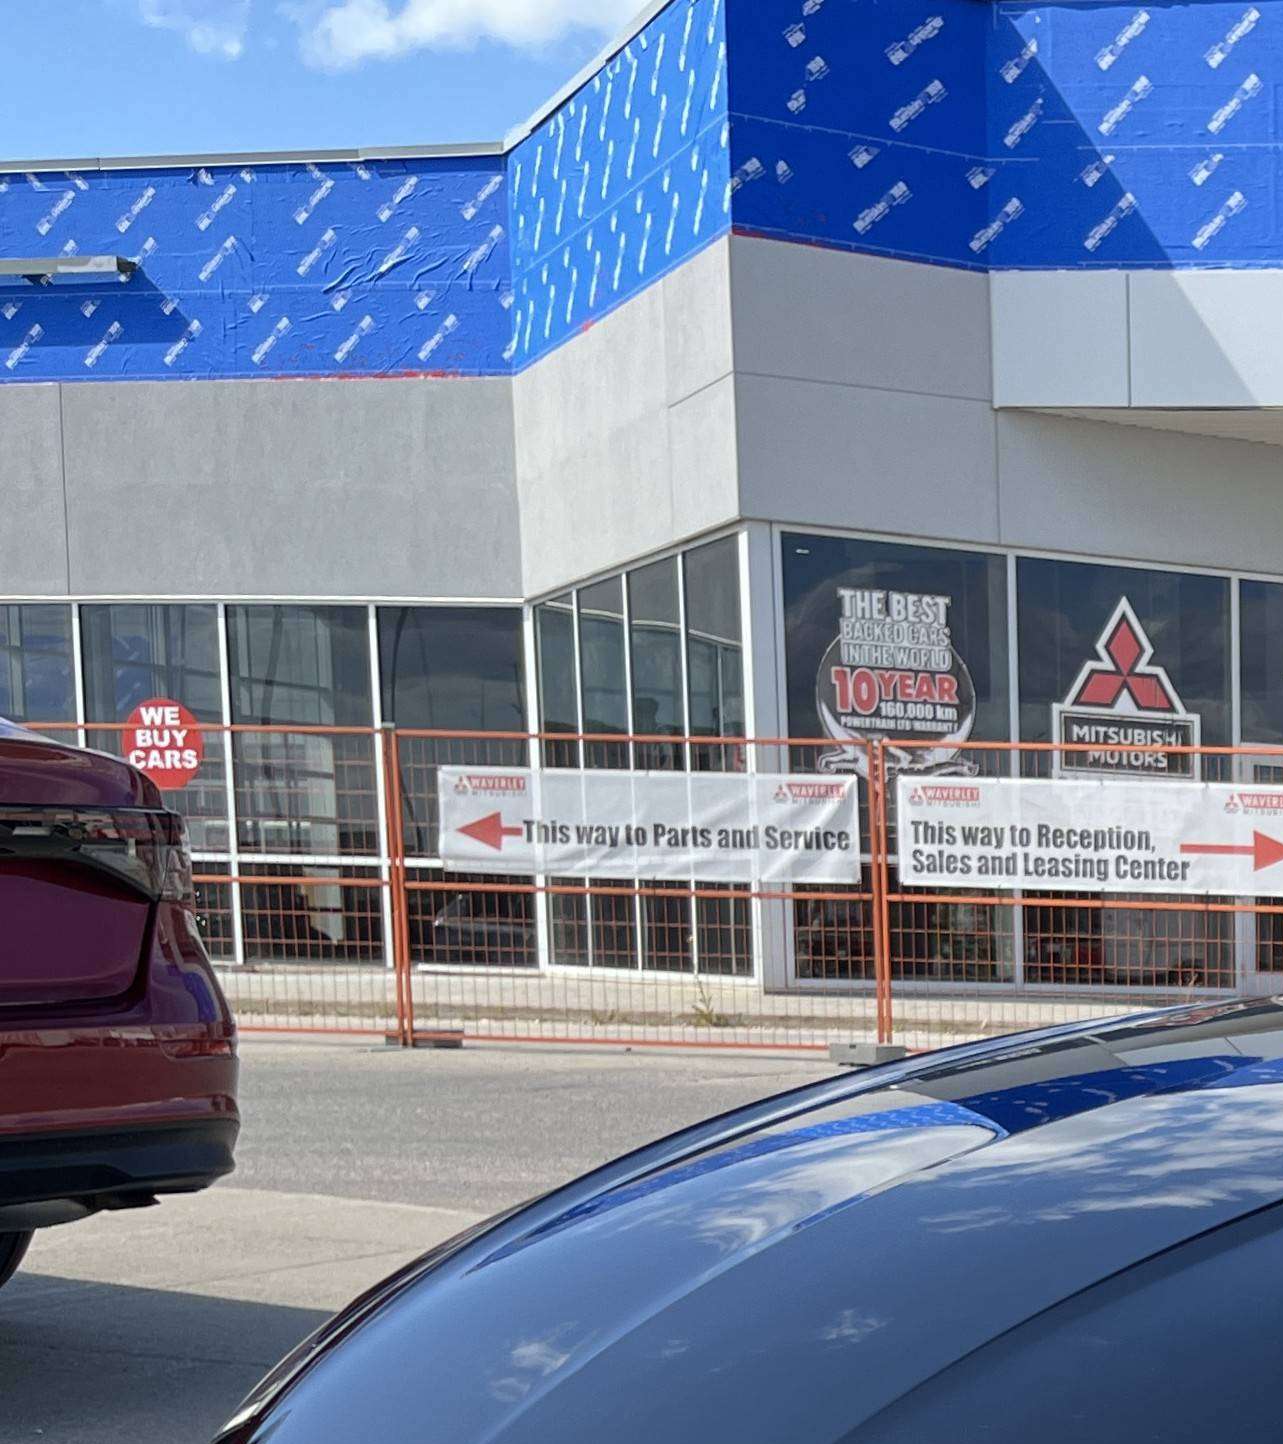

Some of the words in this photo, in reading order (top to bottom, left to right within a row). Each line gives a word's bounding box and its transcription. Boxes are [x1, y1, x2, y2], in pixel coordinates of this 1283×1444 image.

[838, 587, 886, 620] THE
[889, 592, 951, 626] BEST
[841, 620, 903, 644] BACKED
[908, 625, 950, 648] CARS
[842, 644, 861, 665] IN
[862, 645, 893, 667] THE
[894, 647, 952, 670] WORLD
[832, 666, 880, 715] 10
[879, 671, 959, 703] YEAR
[140, 706, 180, 726] WE
[880, 702, 933, 719] 160,000
[936, 705, 958, 720] km
[135, 729, 188, 748] BUY
[1072, 724, 1182, 747] MITSUBISHI
[129, 749, 198, 769] CARS
[1088, 751, 1168, 769] MOTORS
[522, 819, 569, 844] This
[575, 826, 619, 849] way
[624, 822, 647, 845] to
[653, 822, 712, 849] Parts
[717, 825, 759, 850] and
[764, 825, 851, 851] Service
[910, 820, 957, 846] This
[961, 827, 1005, 850] way
[1009, 824, 1032, 848] to
[1036, 825, 1156, 854] Reception,
[911, 848, 971, 875] Sales
[977, 851, 1018, 877] and
[1024, 852, 1110, 881] Leasing
[1115, 855, 1191, 882] Center
